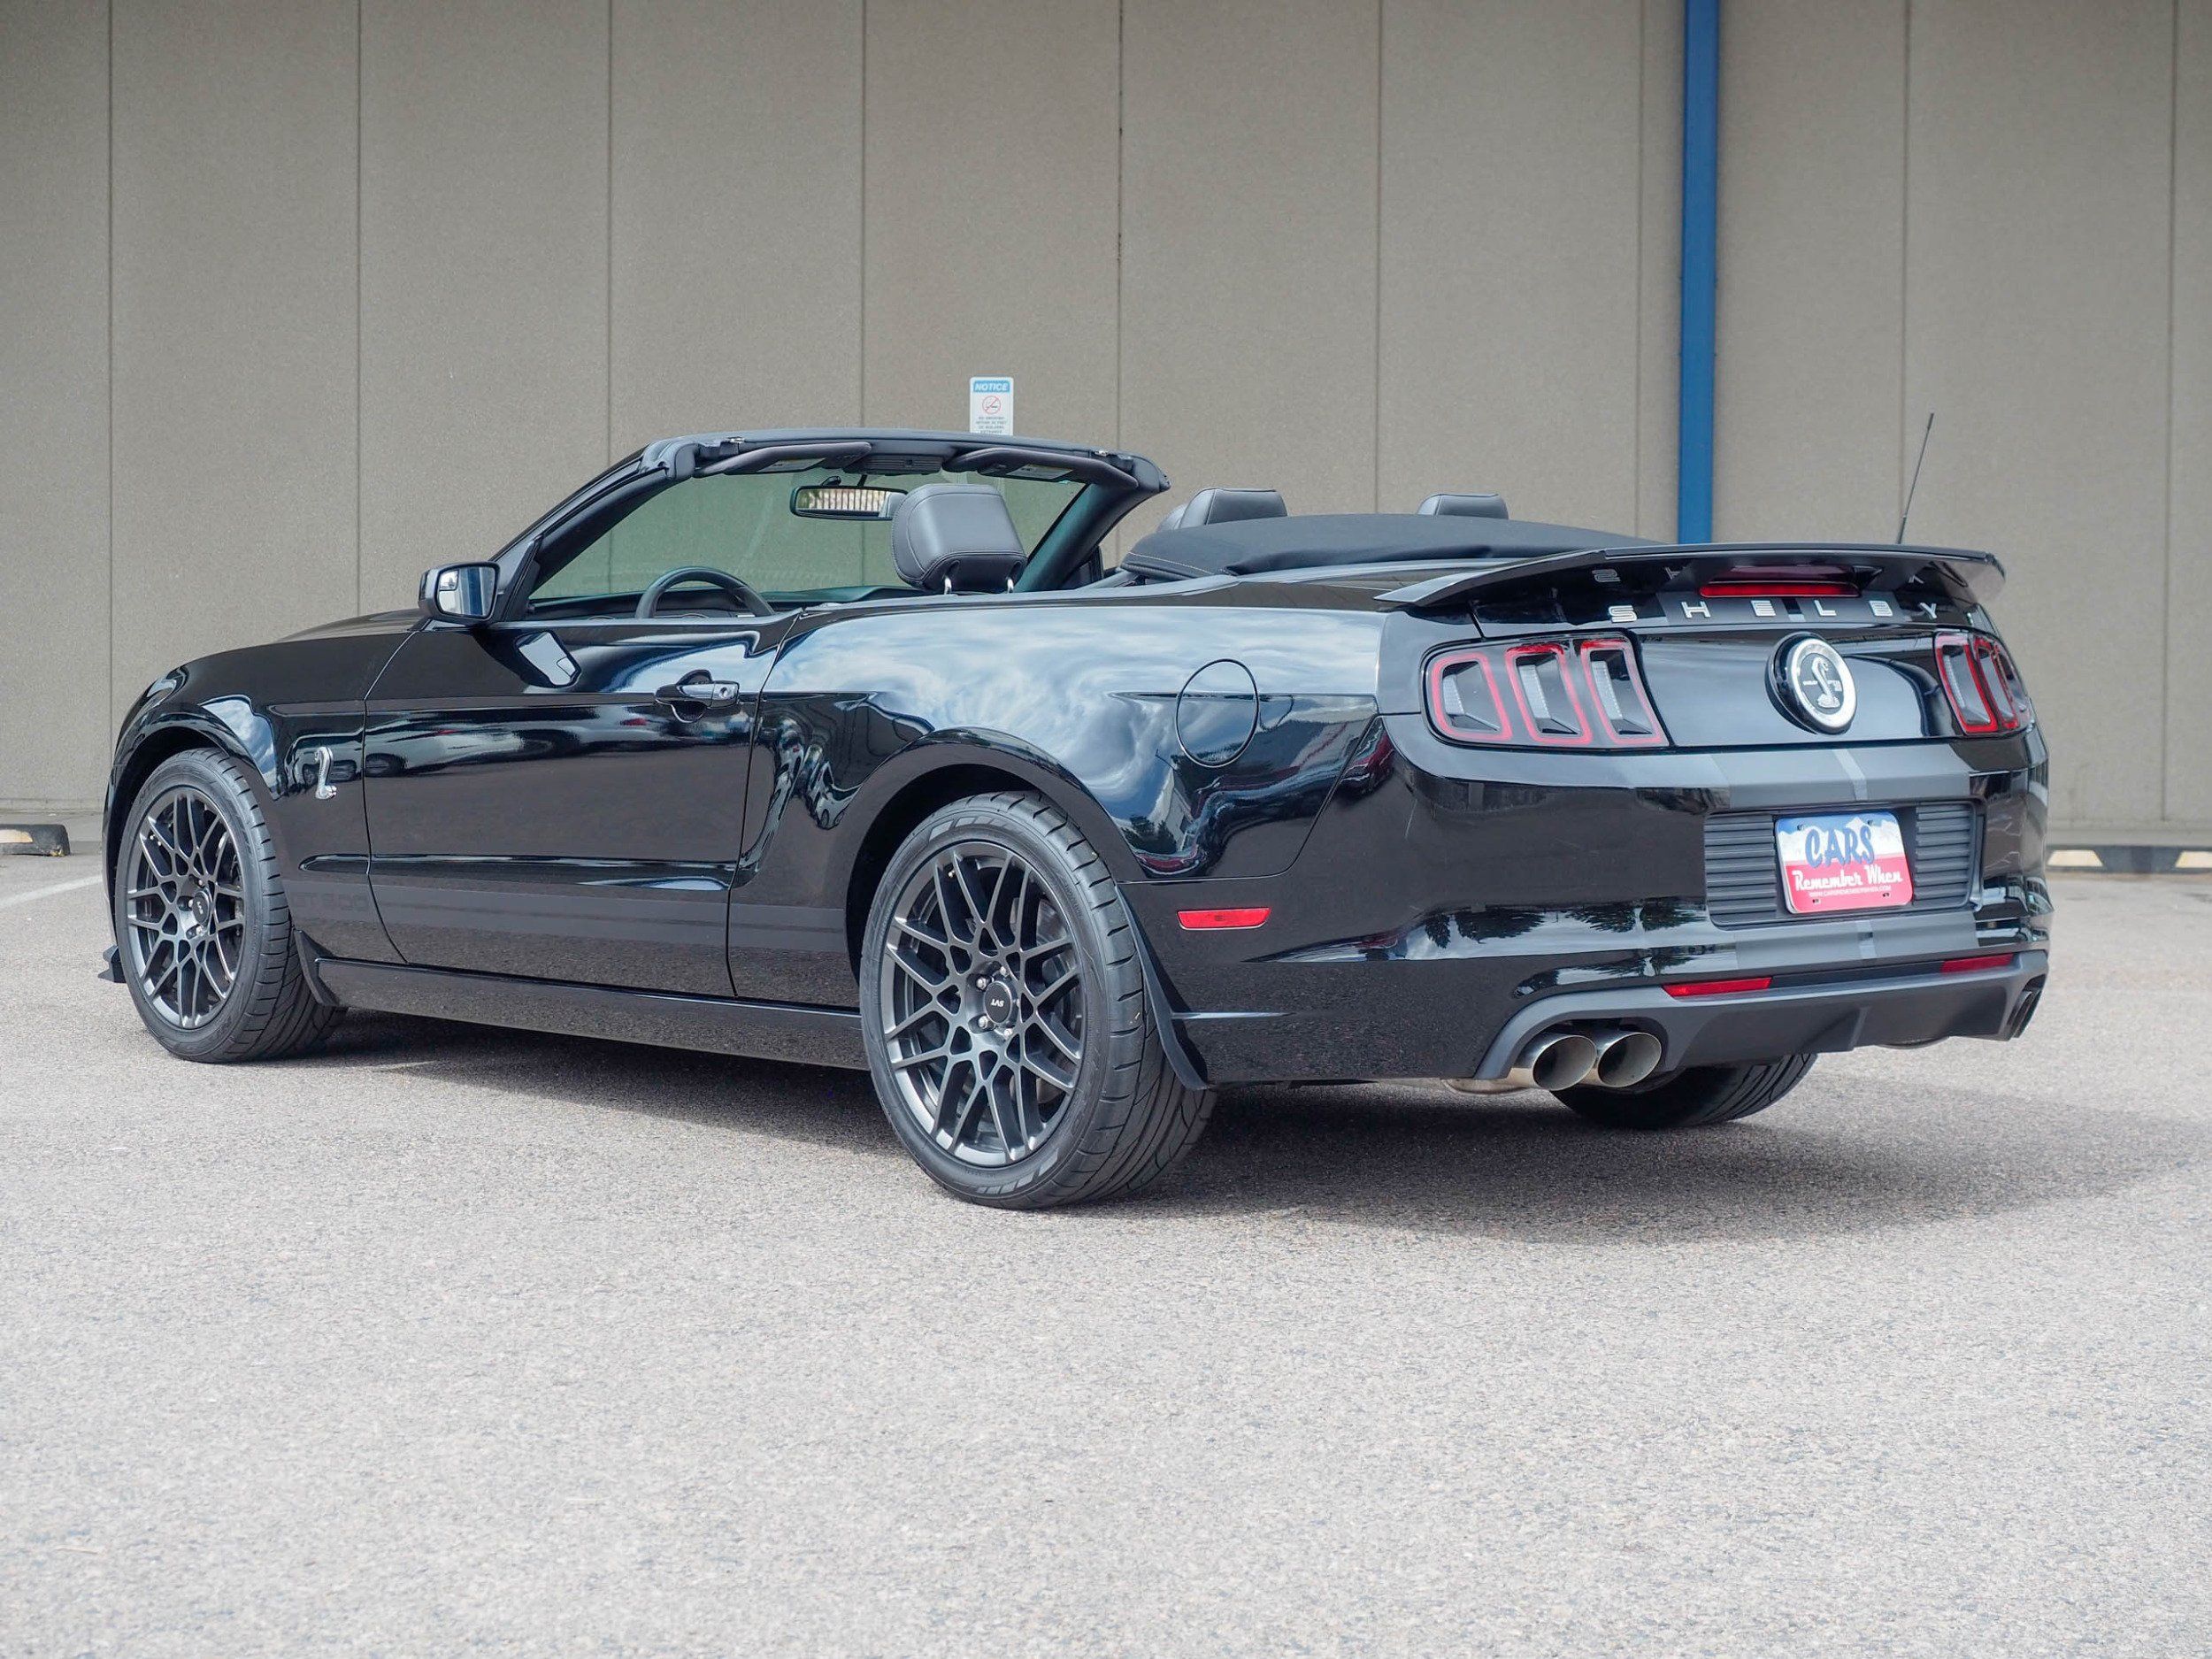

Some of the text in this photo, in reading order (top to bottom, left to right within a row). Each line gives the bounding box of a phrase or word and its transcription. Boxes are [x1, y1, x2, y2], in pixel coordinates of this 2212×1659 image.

[1608, 600, 1938, 622] SHELBY
[1805, 826, 1875, 868] CARS
[1792, 864, 1903, 892] Remember When
